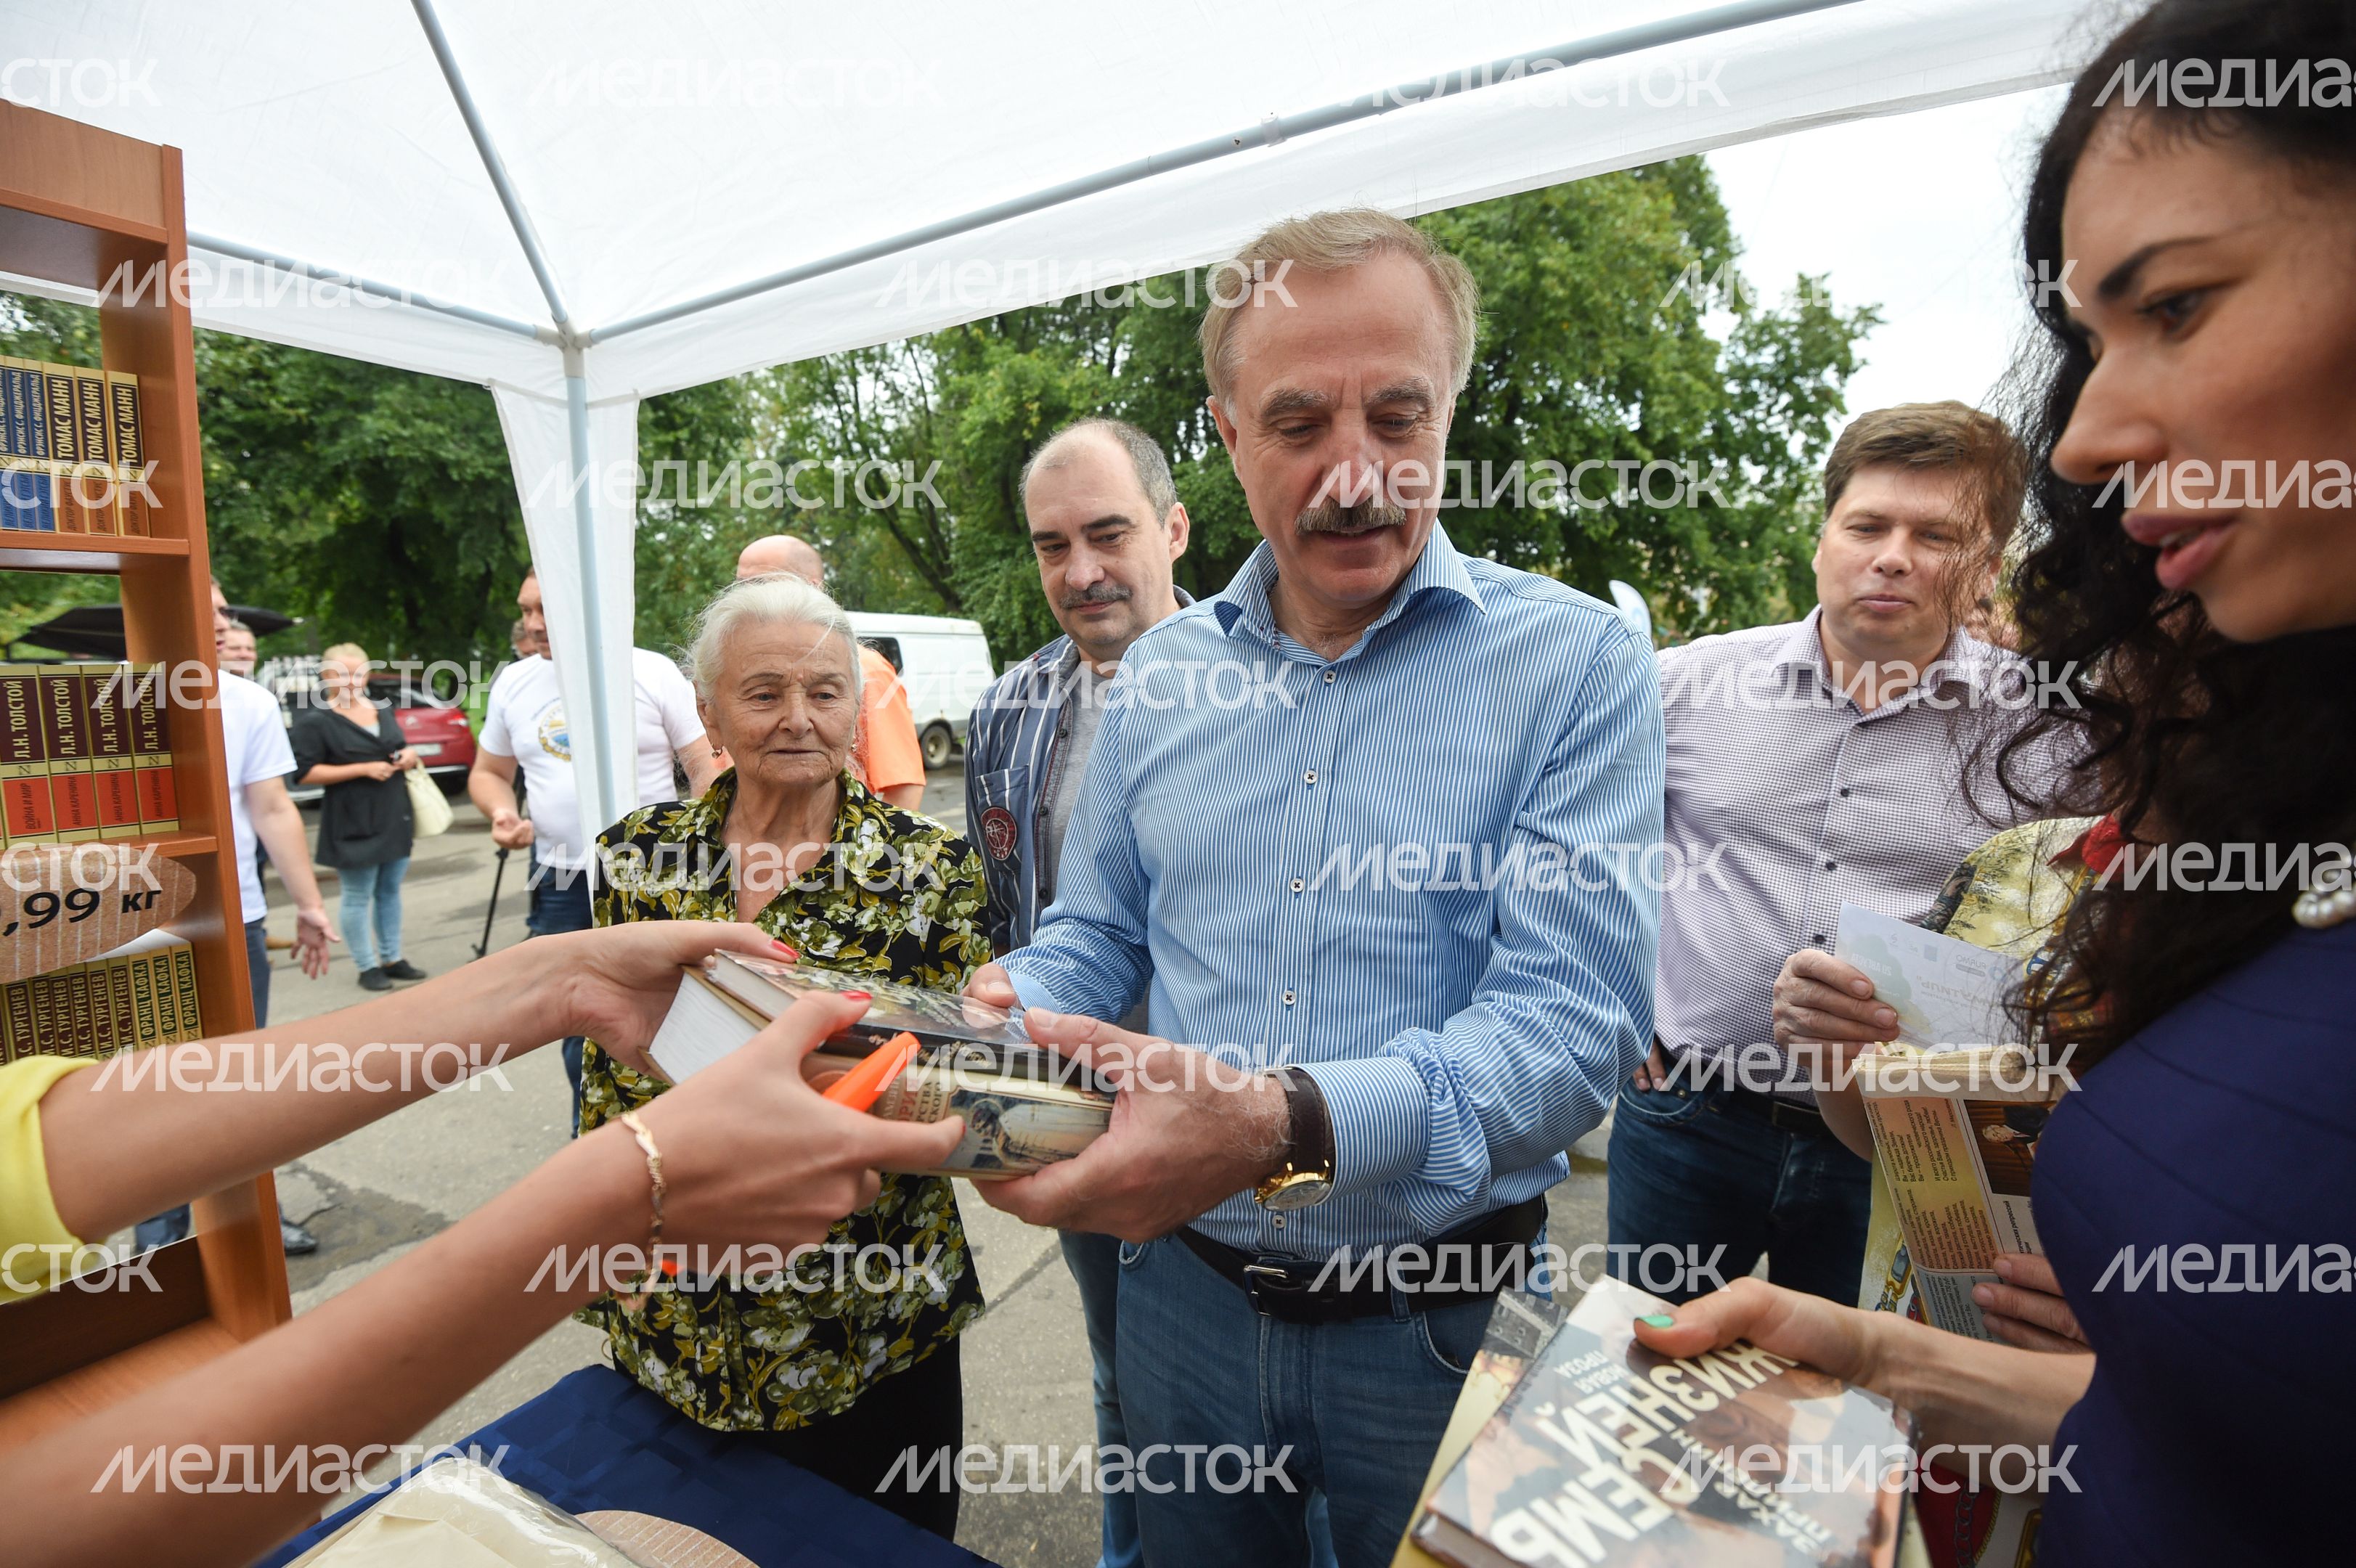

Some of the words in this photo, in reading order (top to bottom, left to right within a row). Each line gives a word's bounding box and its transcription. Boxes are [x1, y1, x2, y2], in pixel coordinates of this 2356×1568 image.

[51, 379, 71, 417] МАНН
[83, 383, 102, 419] МАНН
[116, 388, 135, 424] МАНН
[54, 417, 75, 458] ТОМАС
[86, 420, 105, 459] ТОМАС
[119, 425, 138, 464] ТОМАС
[3, 681, 27, 732] ТОЛСТОЙ
[50, 679, 73, 729] ТОЛСТОЙ
[94, 678, 115, 727] ТОЛСТОЙ
[136, 677, 156, 725] ТОЛСТОЙ
[12, 734, 30, 758] Л.Н.
[60, 731, 77, 754] Л.Н.
[102, 729, 118, 752] Л.Н.
[144, 727, 158, 749] Л.Н.
[20, 783, 32, 799] МИР
[23, 807, 36, 830] ВОЙНА
[72, 811, 81, 825] АННА
[114, 807, 123, 821] АННА
[0, 888, 100, 936] ,99
[122, 890, 161, 913] кг
[132, 963, 150, 999] КАФКА
[155, 960, 171, 995] КАФКА
[176, 955, 192, 990] КАФКА
[11, 988, 31, 1041] ТУРГЕНЕВ
[35, 981, 52, 1034] ТУРГЕНЕВ
[54, 981, 71, 1033] ТУРГЕНЕВ
[73, 977, 90, 1028] ТУРГЕНЕВ
[92, 975, 109, 1027] ТУРГЕНЕВ
[114, 970, 131, 1024] ТУРГЕНЕВ
[158, 995, 175, 1030] ФРАНЦ
[181, 990, 197, 1025] ФРАНЦ
[118, 1024, 134, 1044] И.С.
[136, 1000, 155, 1035] ФРАНЦ
[78, 1029, 92, 1051] И.С.
[99, 1028, 113, 1049] И.С.
[1553, 1349, 1610, 1379] ПРОЗА
[1573, 1363, 1631, 1395] НОВАЯ
[1491, 1445, 1700, 1568] СЕМЬ
